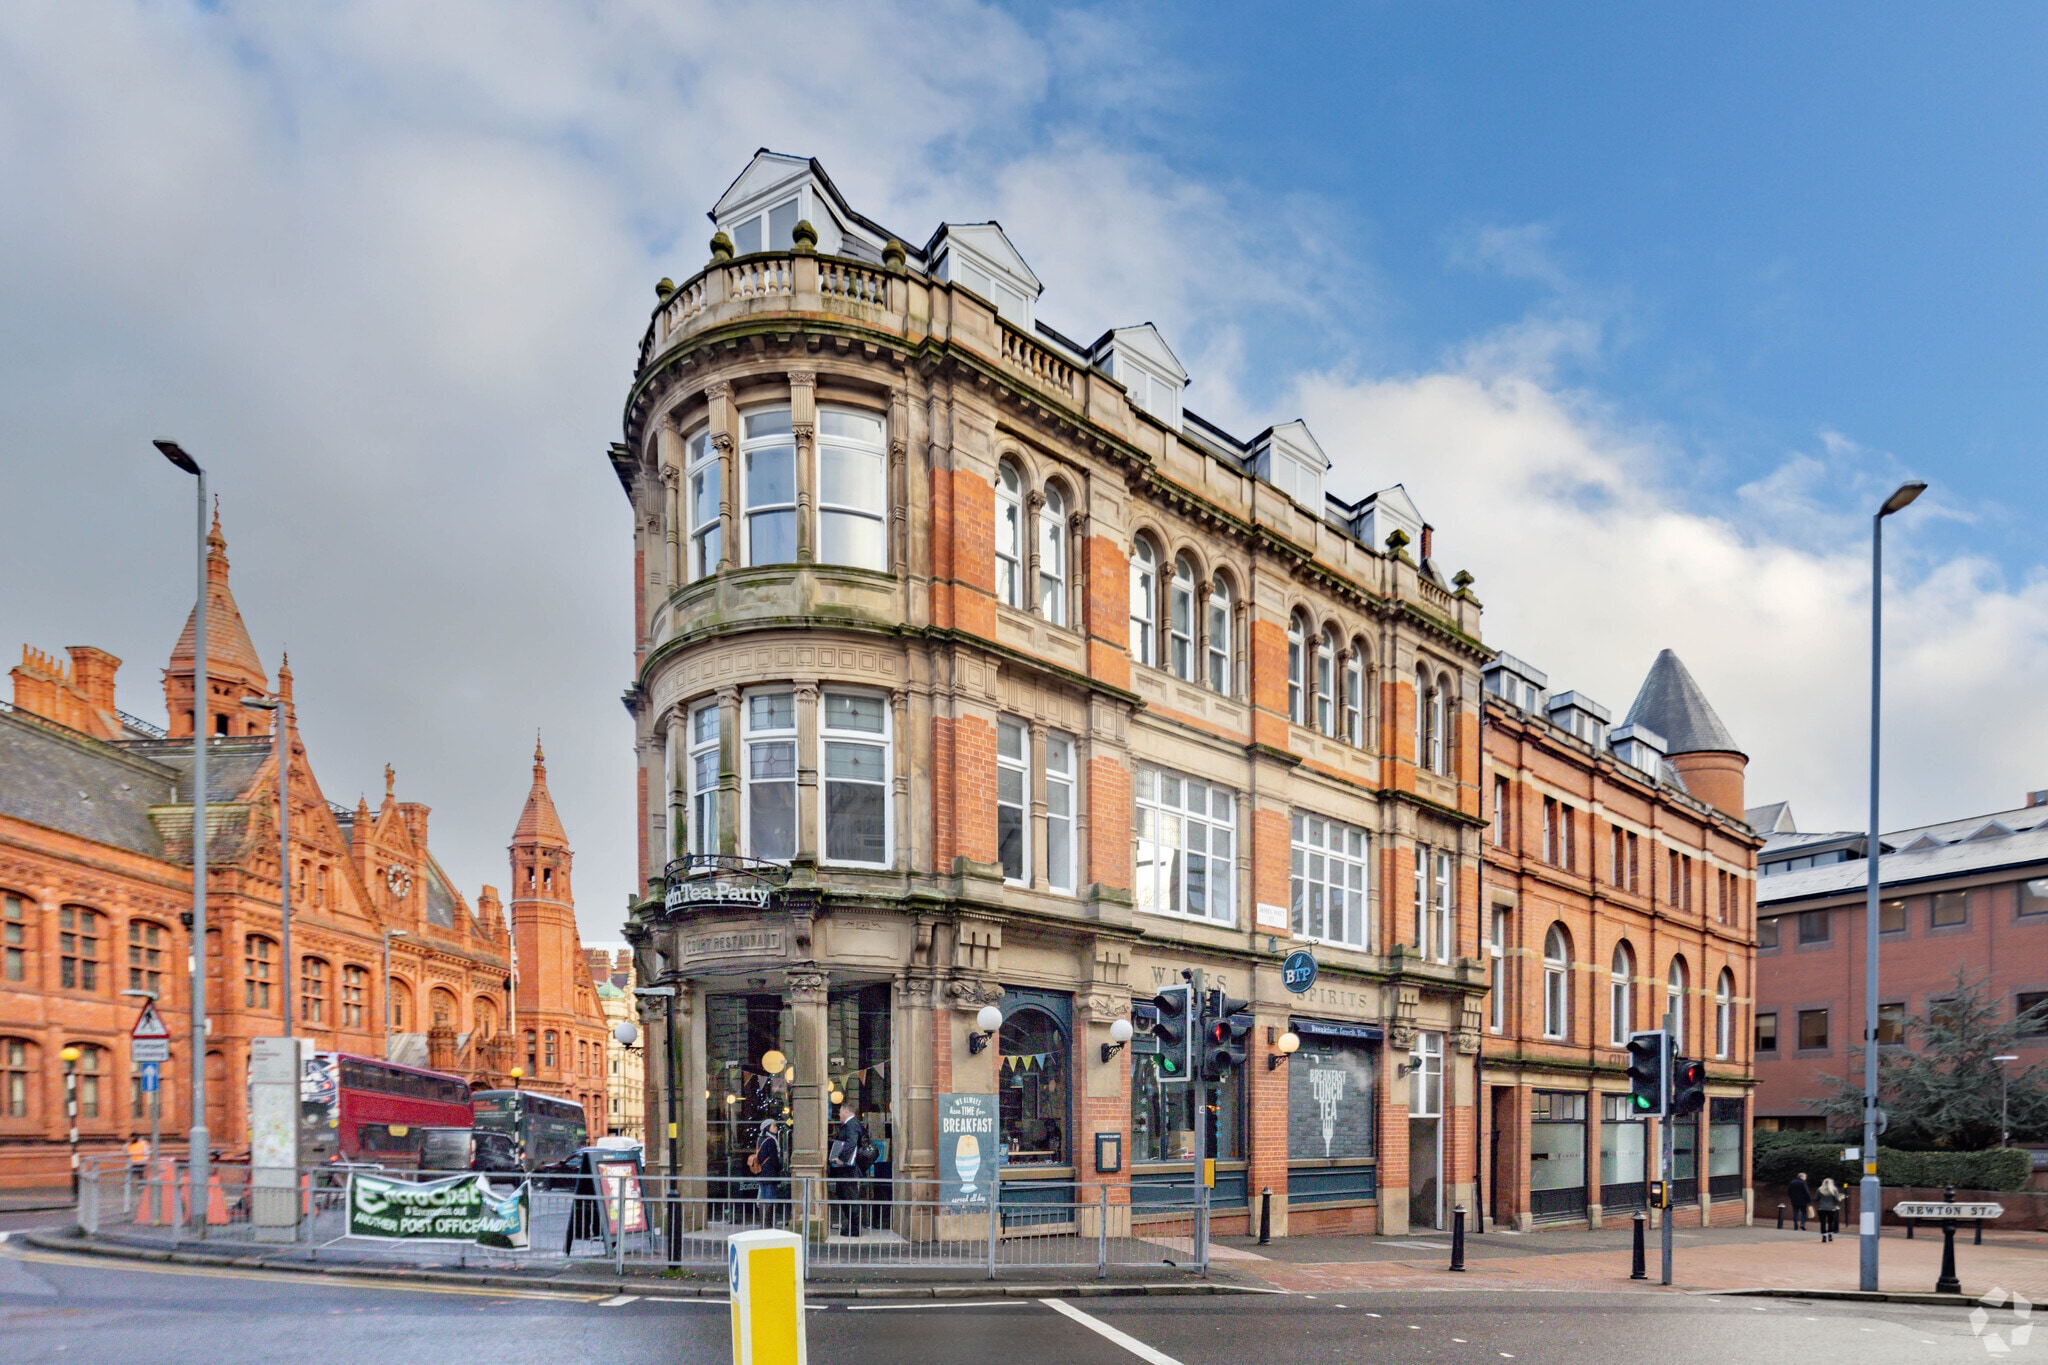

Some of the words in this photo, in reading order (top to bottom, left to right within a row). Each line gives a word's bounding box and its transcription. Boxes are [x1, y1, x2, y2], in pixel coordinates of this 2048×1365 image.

[680, 884, 714, 902] Tea
[715, 882, 770, 908] Party
[1285, 967, 1311, 984] BTP
[1309, 1069, 1347, 1084] BREAKFAST
[1313, 1080, 1343, 1101] LUNCH
[963, 1096, 982, 1106] ALWAYS
[961, 1106, 975, 1116] TIME
[1318, 1099, 1338, 1120] TEA
[943, 1117, 993, 1133] BREAKFAST
[1906, 1206, 1962, 1215] NEWTON
[1971, 1206, 1987, 1215] ST
[353, 1211, 398, 1233] ANOTHER
[400, 1217, 433, 1234] POST
[435, 1218, 480, 1234] OFFICE
